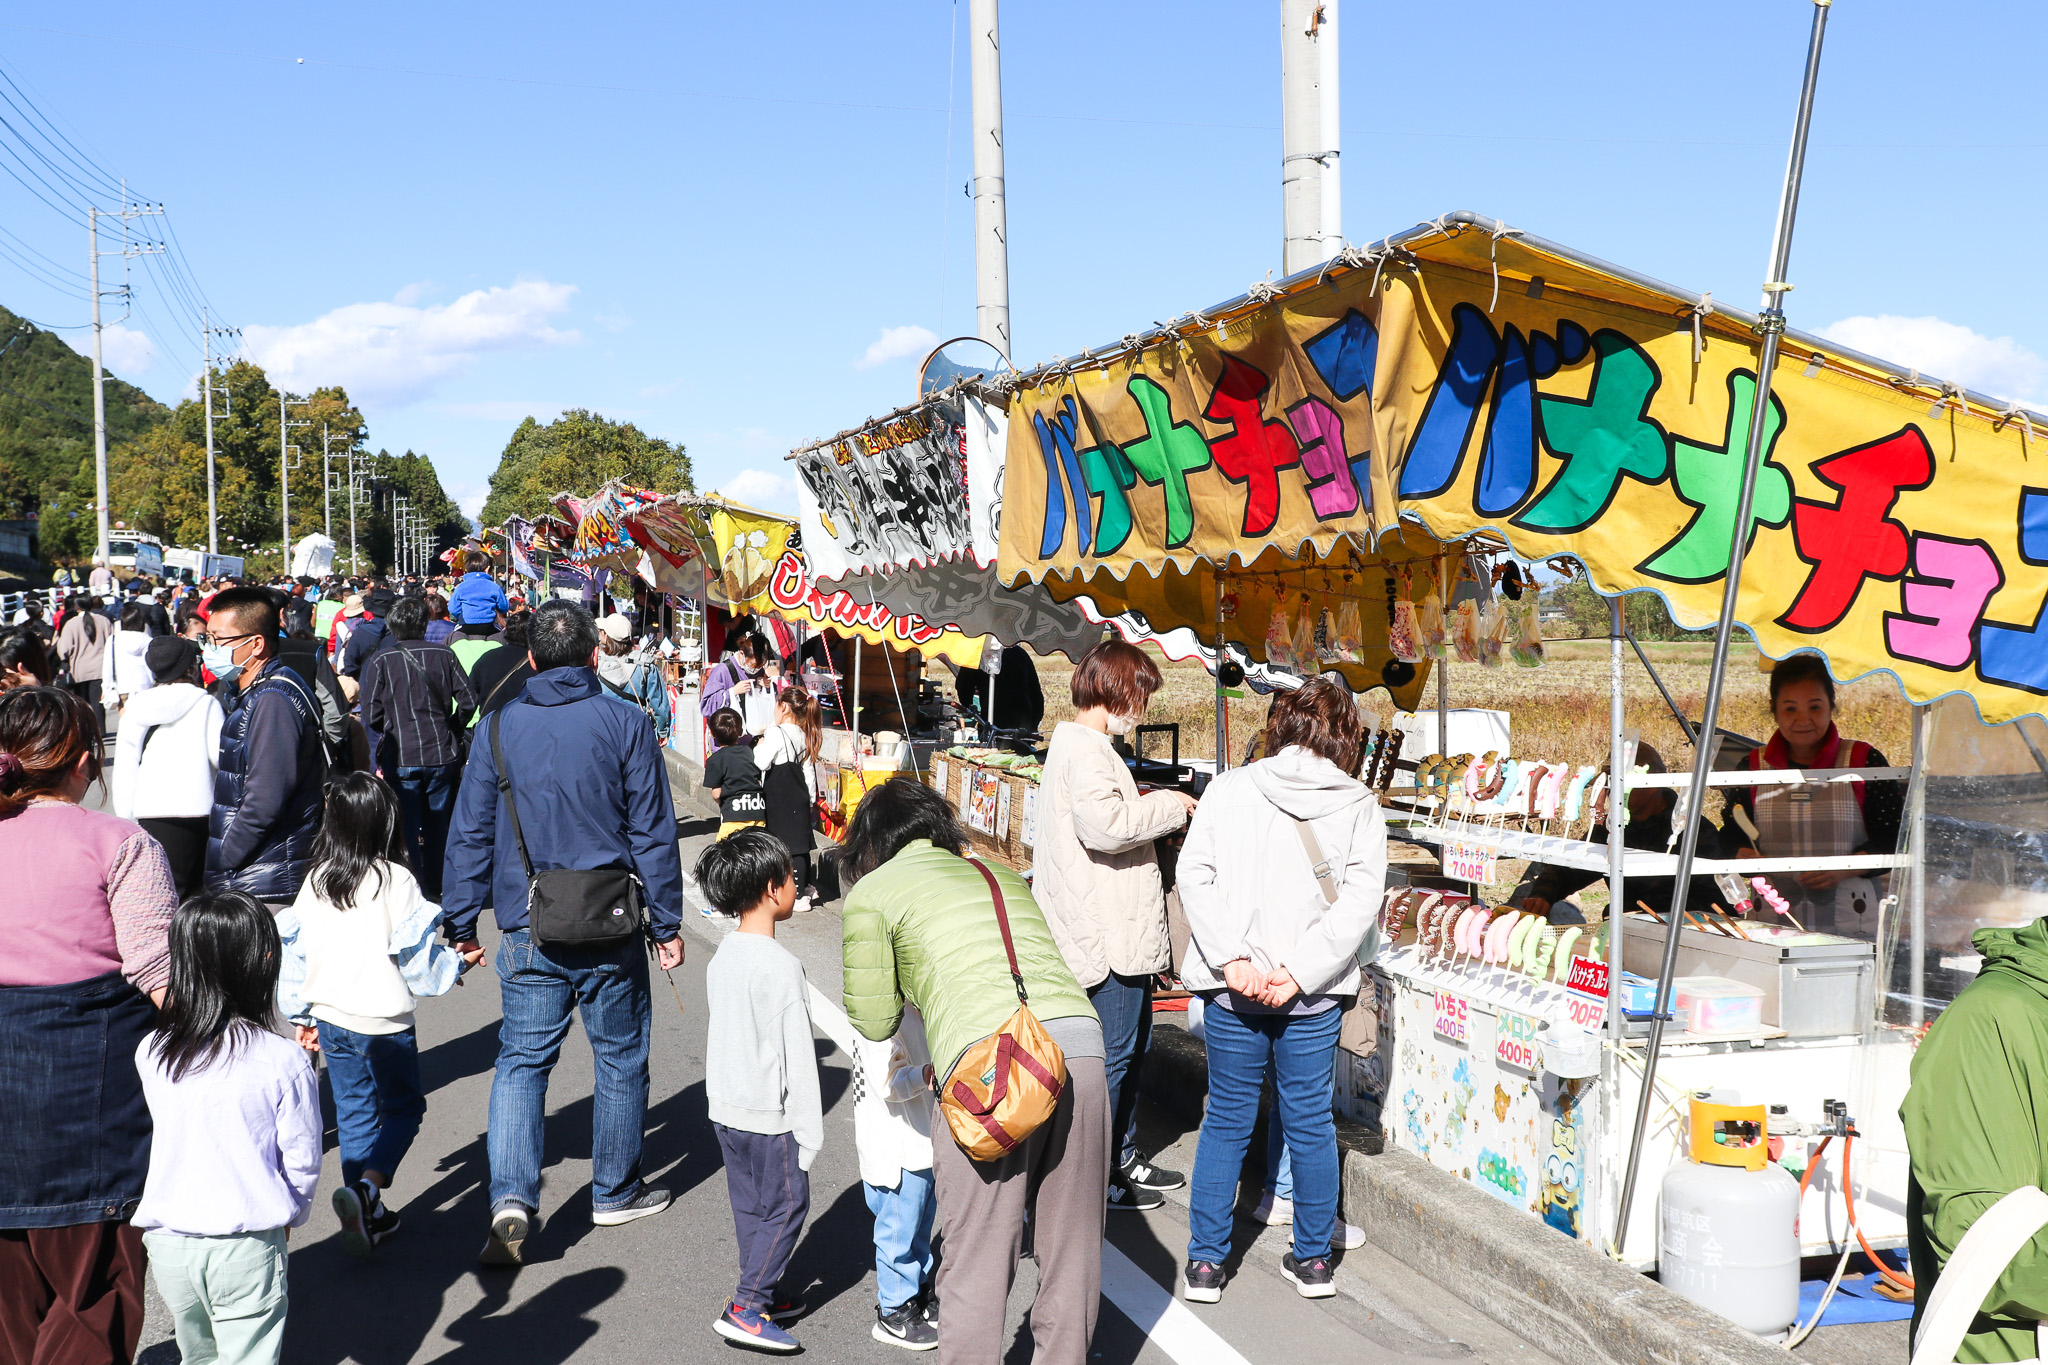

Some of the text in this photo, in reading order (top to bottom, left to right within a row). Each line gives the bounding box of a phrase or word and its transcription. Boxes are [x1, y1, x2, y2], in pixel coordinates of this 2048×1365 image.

[1444, 845, 1495, 862] いろいろキャラクター
[1453, 861, 1483, 882] 700円
[1434, 990, 1467, 1021] いちご
[1566, 998, 1604, 1029] 00円
[1436, 1019, 1465, 1040] 400円
[1498, 1013, 1537, 1042] メロン
[1497, 1040, 1532, 1066] 400円
[1129, 1164, 1152, 1183] N
[1107, 1184, 1126, 1203] N
